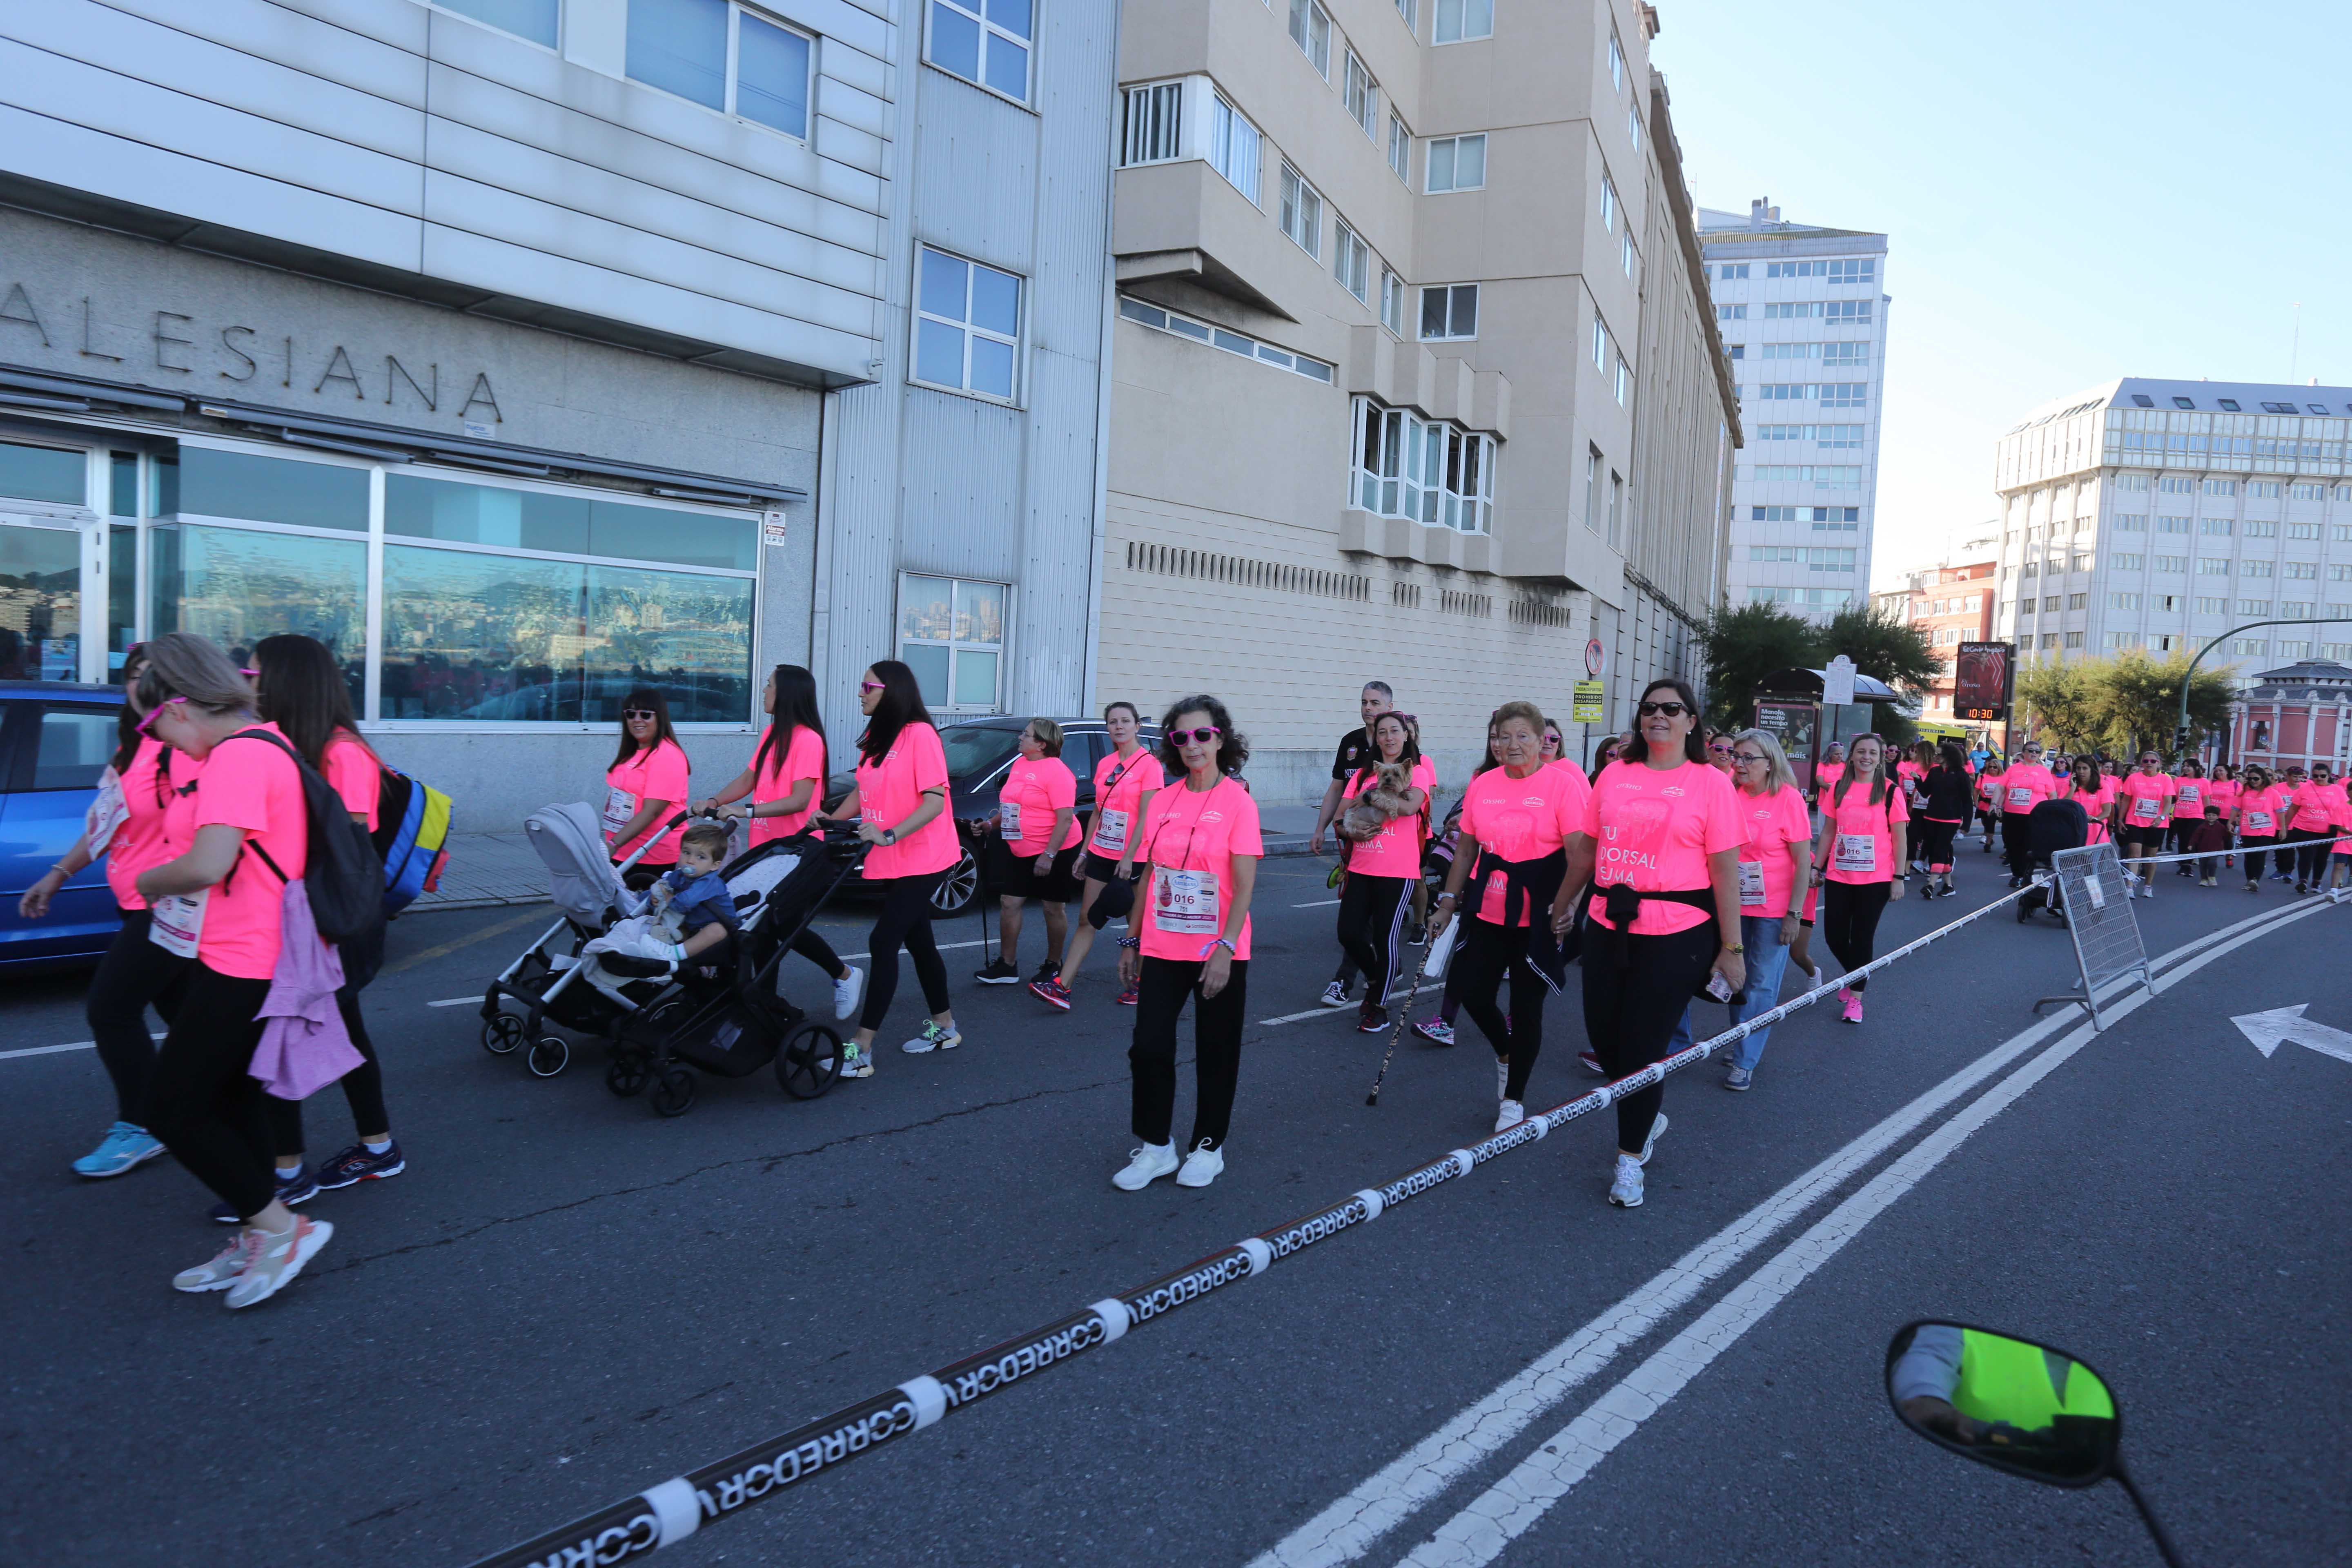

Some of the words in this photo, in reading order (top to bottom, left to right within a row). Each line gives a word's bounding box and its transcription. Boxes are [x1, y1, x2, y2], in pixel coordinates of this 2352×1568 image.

[1968, 708, 1993, 719] 10:30
[753, 817, 768, 827] MA
[1600, 846, 1655, 869] DORSAL
[1600, 866, 1635, 885] SUMA
[1174, 894, 1195, 904] 016
[1274, 1190, 1369, 1256] CORREDOR
[1136, 1252, 1253, 1321] CORREDOR
[956, 1317, 1105, 1402] CORREDOR
[719, 1401, 917, 1510] CORREDOR
